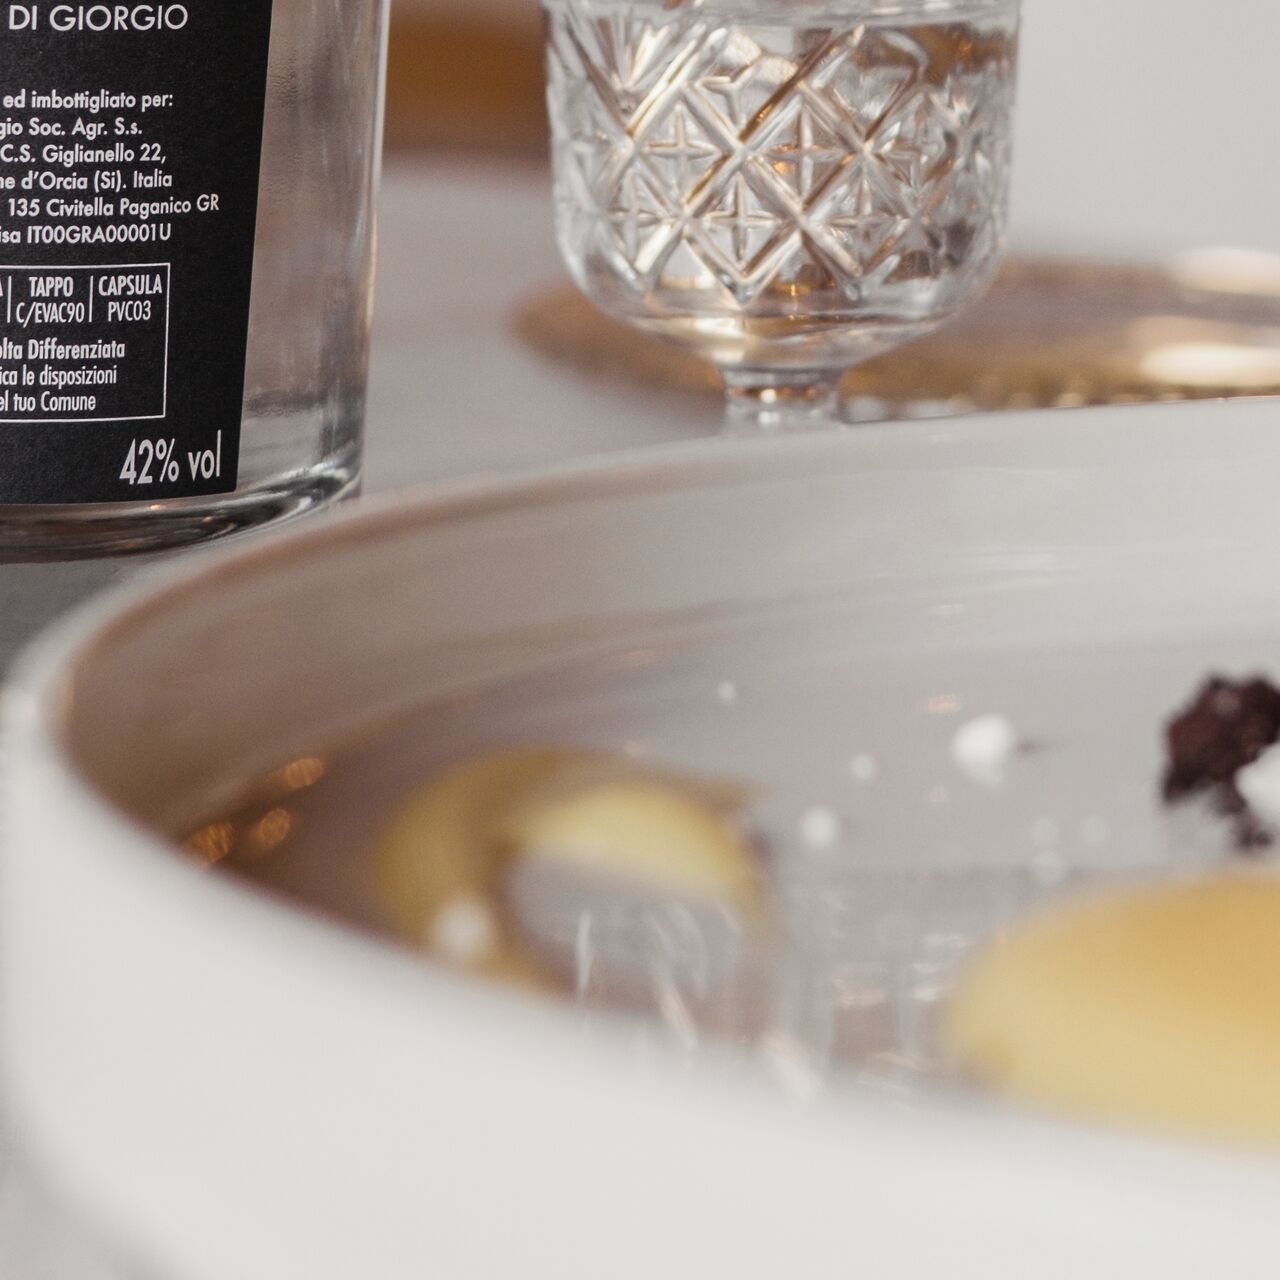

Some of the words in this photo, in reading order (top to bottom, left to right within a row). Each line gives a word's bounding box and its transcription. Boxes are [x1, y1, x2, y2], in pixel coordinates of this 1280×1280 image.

[8, 4, 38, 31] DI
[49, 3, 189, 32] GIORGIO
[2, 88, 26, 109] ed
[31, 88, 137, 114] imbottigliato
[141, 94, 173, 113] per:
[28, 116, 66, 136] Soc.
[71, 117, 108, 141] Agr.
[114, 116, 143, 136] S.s.
[0, 143, 36, 163] C.S.
[42, 142, 135, 168] Giglianello
[140, 142, 166, 164] 22,
[20, 169, 88, 190] d'Orcia
[93, 169, 127, 193] (Si).
[133, 169, 173, 188] Italia
[8, 197, 41, 217] 135
[45, 196, 114, 217] Civitella
[119, 196, 192, 220] Paganico
[196, 193, 219, 212] GR
[26, 222, 172, 244] IT00GRA00001U
[28, 276, 74, 298] TAPPO
[98, 273, 163, 297] CAPSULA
[15, 301, 85, 329] C/EVAC90
[107, 299, 152, 322] PVC03
[27, 336, 126, 360] Differenziata
[22, 363, 36, 386] le
[39, 364, 118, 390] disposizioni
[13, 393, 37, 412] tuo
[40, 390, 97, 412] Comune
[119, 438, 180, 485] 42%
[187, 429, 222, 480] vol
